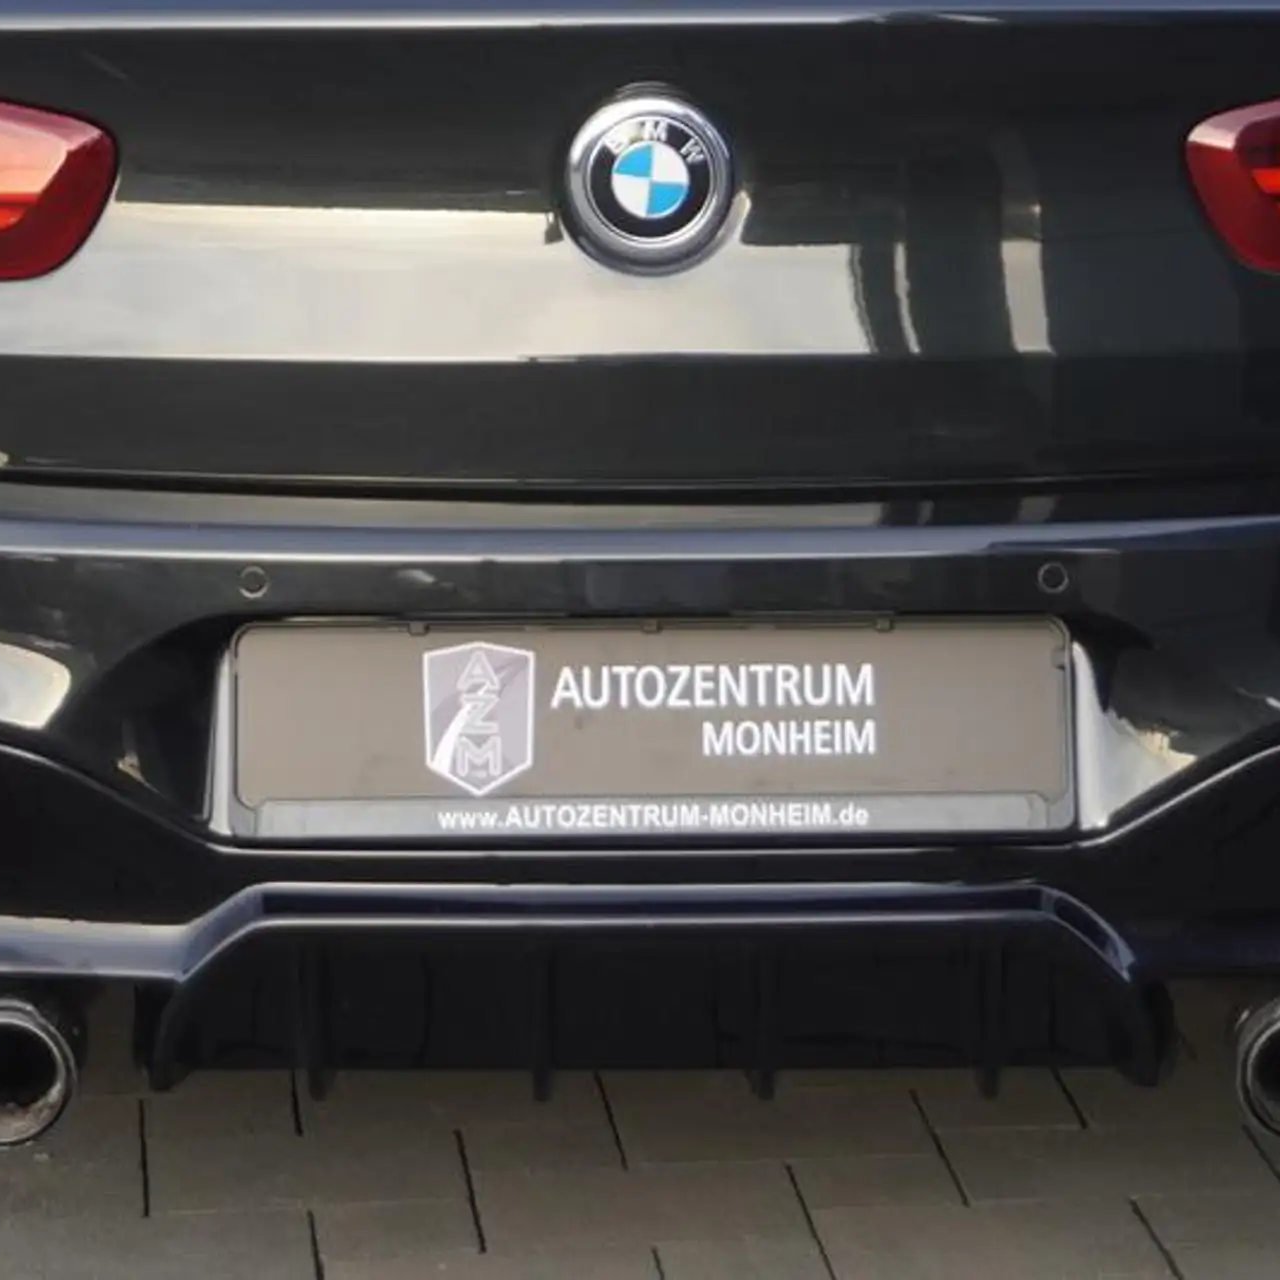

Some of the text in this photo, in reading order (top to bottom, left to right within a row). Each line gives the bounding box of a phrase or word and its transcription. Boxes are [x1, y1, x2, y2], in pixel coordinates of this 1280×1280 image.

[550, 663, 876, 709] AUTOZENTRUM
[455, 650, 503, 777] AZM
[702, 719, 877, 757] MONHEIM
[437, 802, 870, 830] www.AUTOZENTRUM-MONHEIM.de
